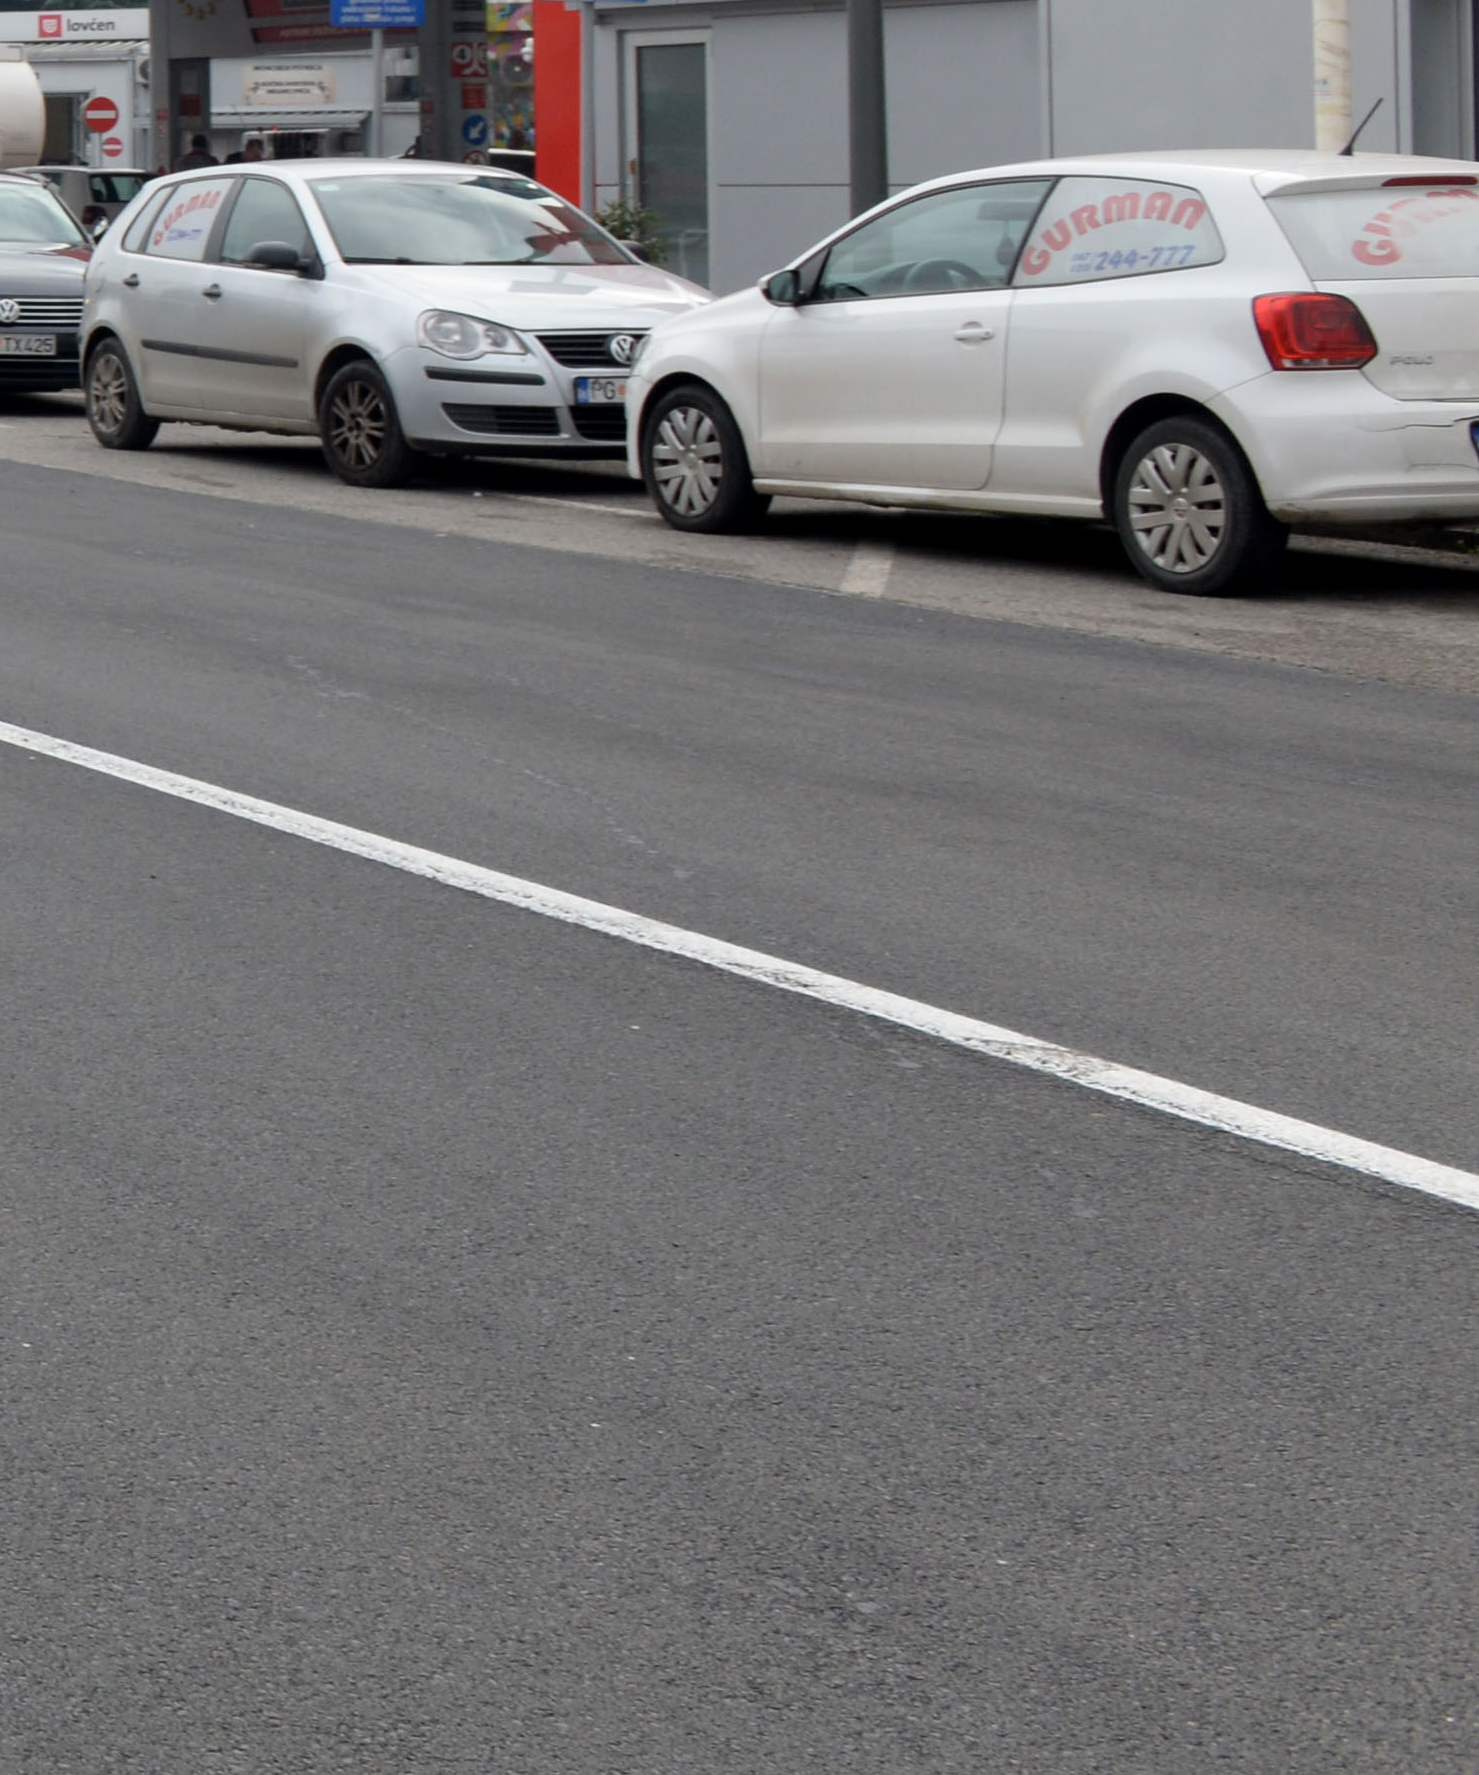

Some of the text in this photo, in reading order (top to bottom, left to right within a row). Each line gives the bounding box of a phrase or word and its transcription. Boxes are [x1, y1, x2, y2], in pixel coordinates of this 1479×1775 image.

[455, 45, 468, 61] 4
[1021, 191, 1206, 275] GURMAN
[1094, 245, 1196, 271] 244-777
[4, 338, 53, 353] TX425
[1390, 356, 1435, 365] POLO
[591, 379, 615, 401] PG
